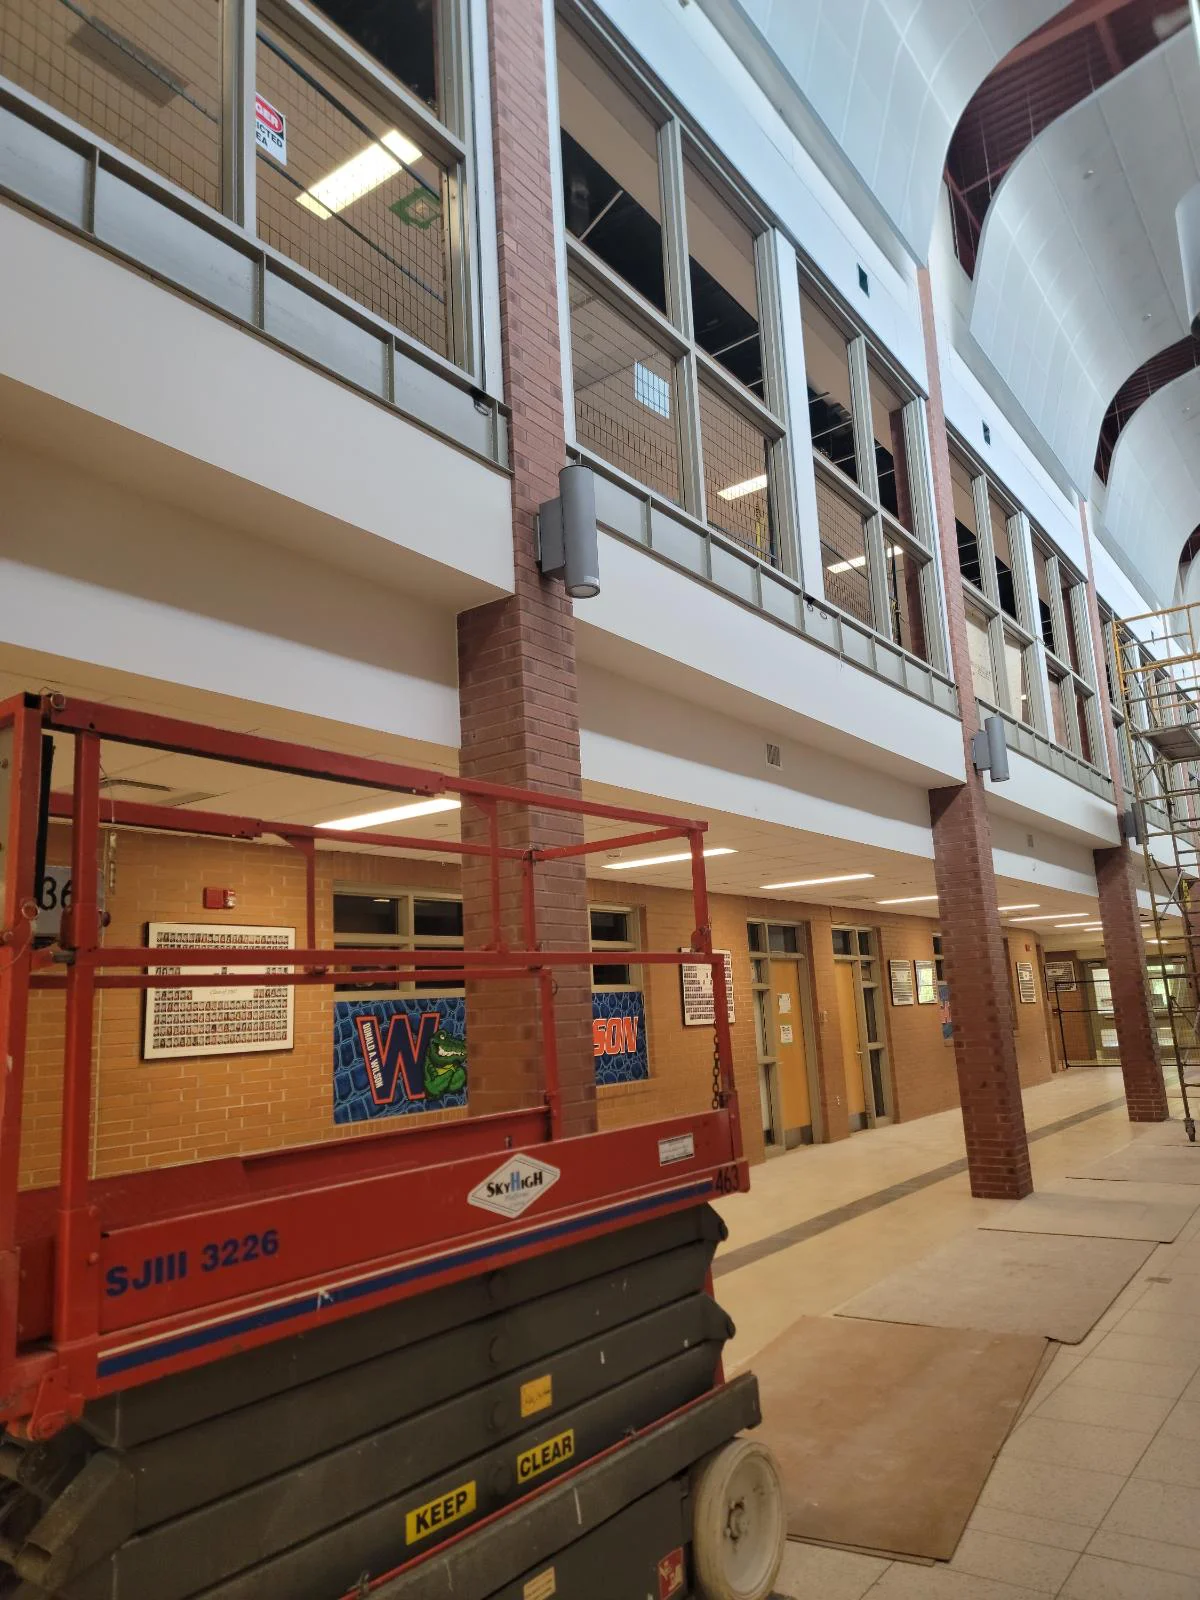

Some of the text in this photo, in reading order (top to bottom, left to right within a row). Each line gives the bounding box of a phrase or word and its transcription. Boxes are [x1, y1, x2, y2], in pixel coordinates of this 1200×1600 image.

[362, 1022, 376, 1051] DONALD
[370, 1058, 385, 1089] WILSON
[715, 1164, 740, 1195] 463
[105, 1229, 280, 1297] SJIII 3226
[519, 1436, 573, 1478] CLEAR
[415, 1490, 468, 1535] KEEP
